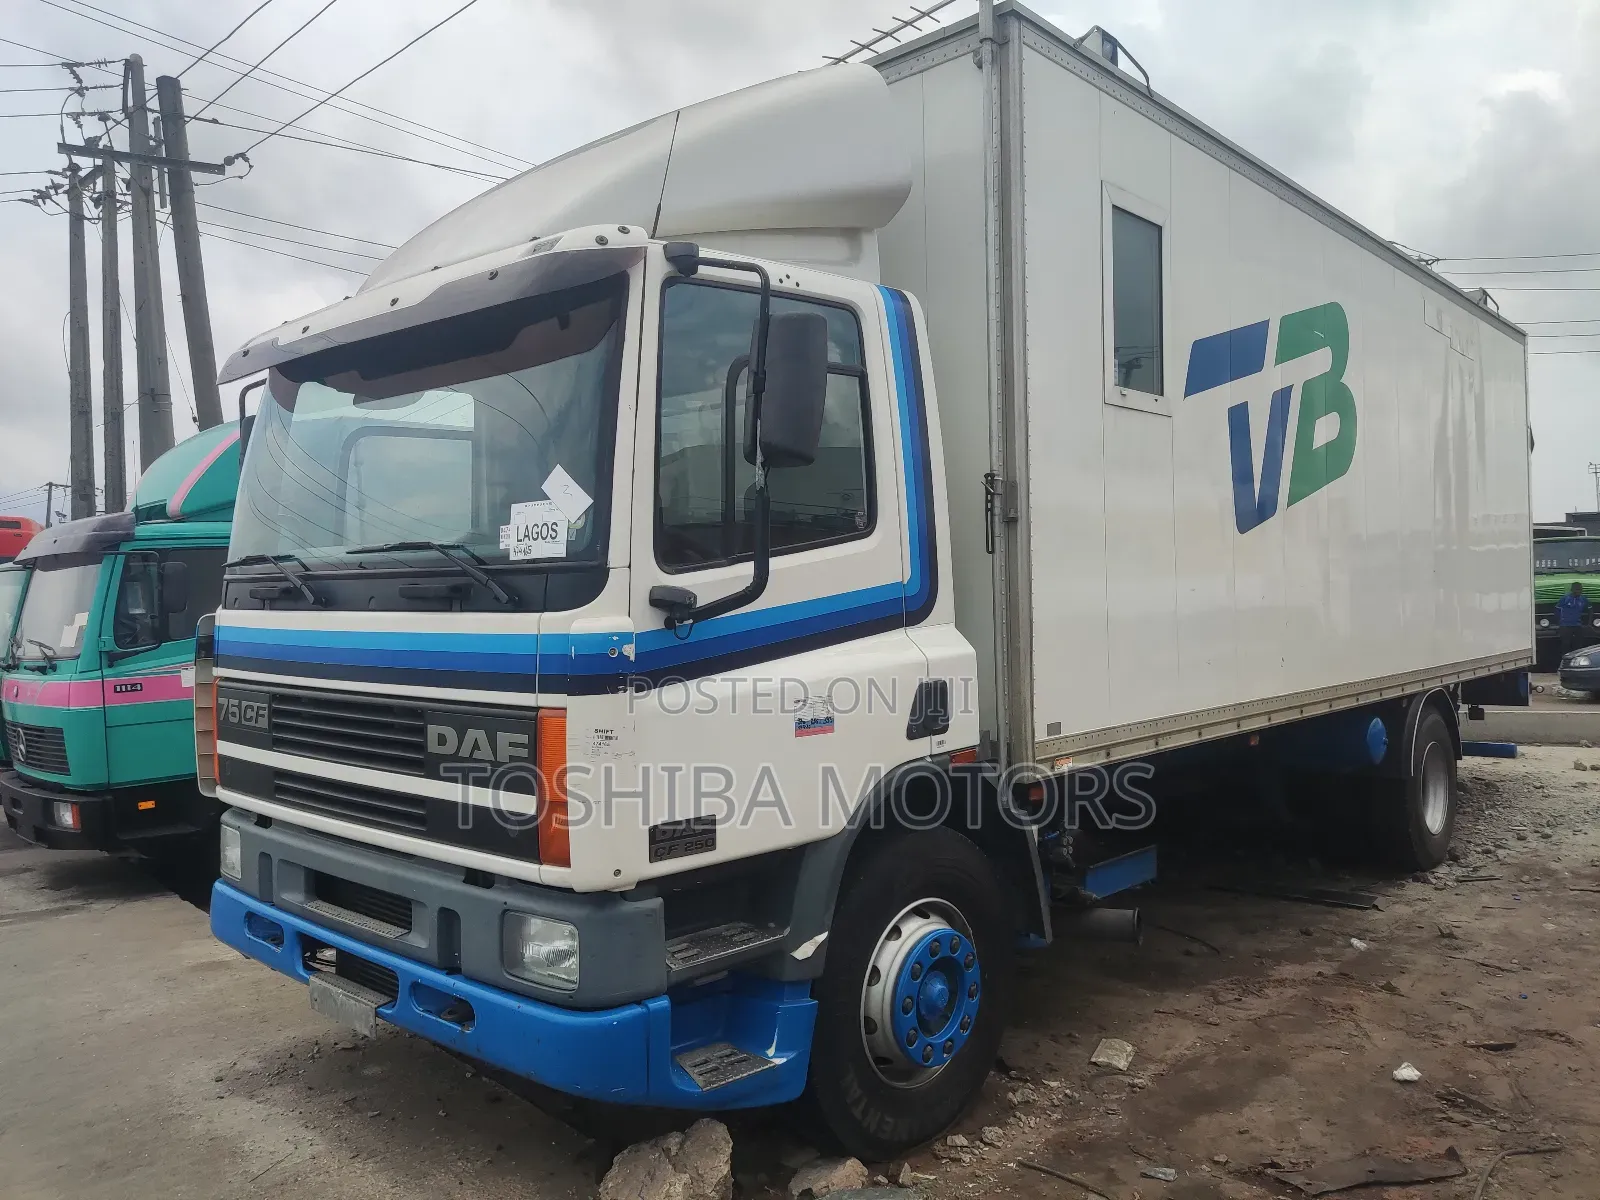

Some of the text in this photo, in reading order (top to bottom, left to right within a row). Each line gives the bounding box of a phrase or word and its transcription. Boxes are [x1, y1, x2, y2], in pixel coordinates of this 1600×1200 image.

[516, 522, 559, 543] LAGOS
[115, 683, 142, 692] 1114
[217, 697, 269, 729] 75CF
[426, 724, 530, 763] DAF
[684, 837, 715, 852] 250
